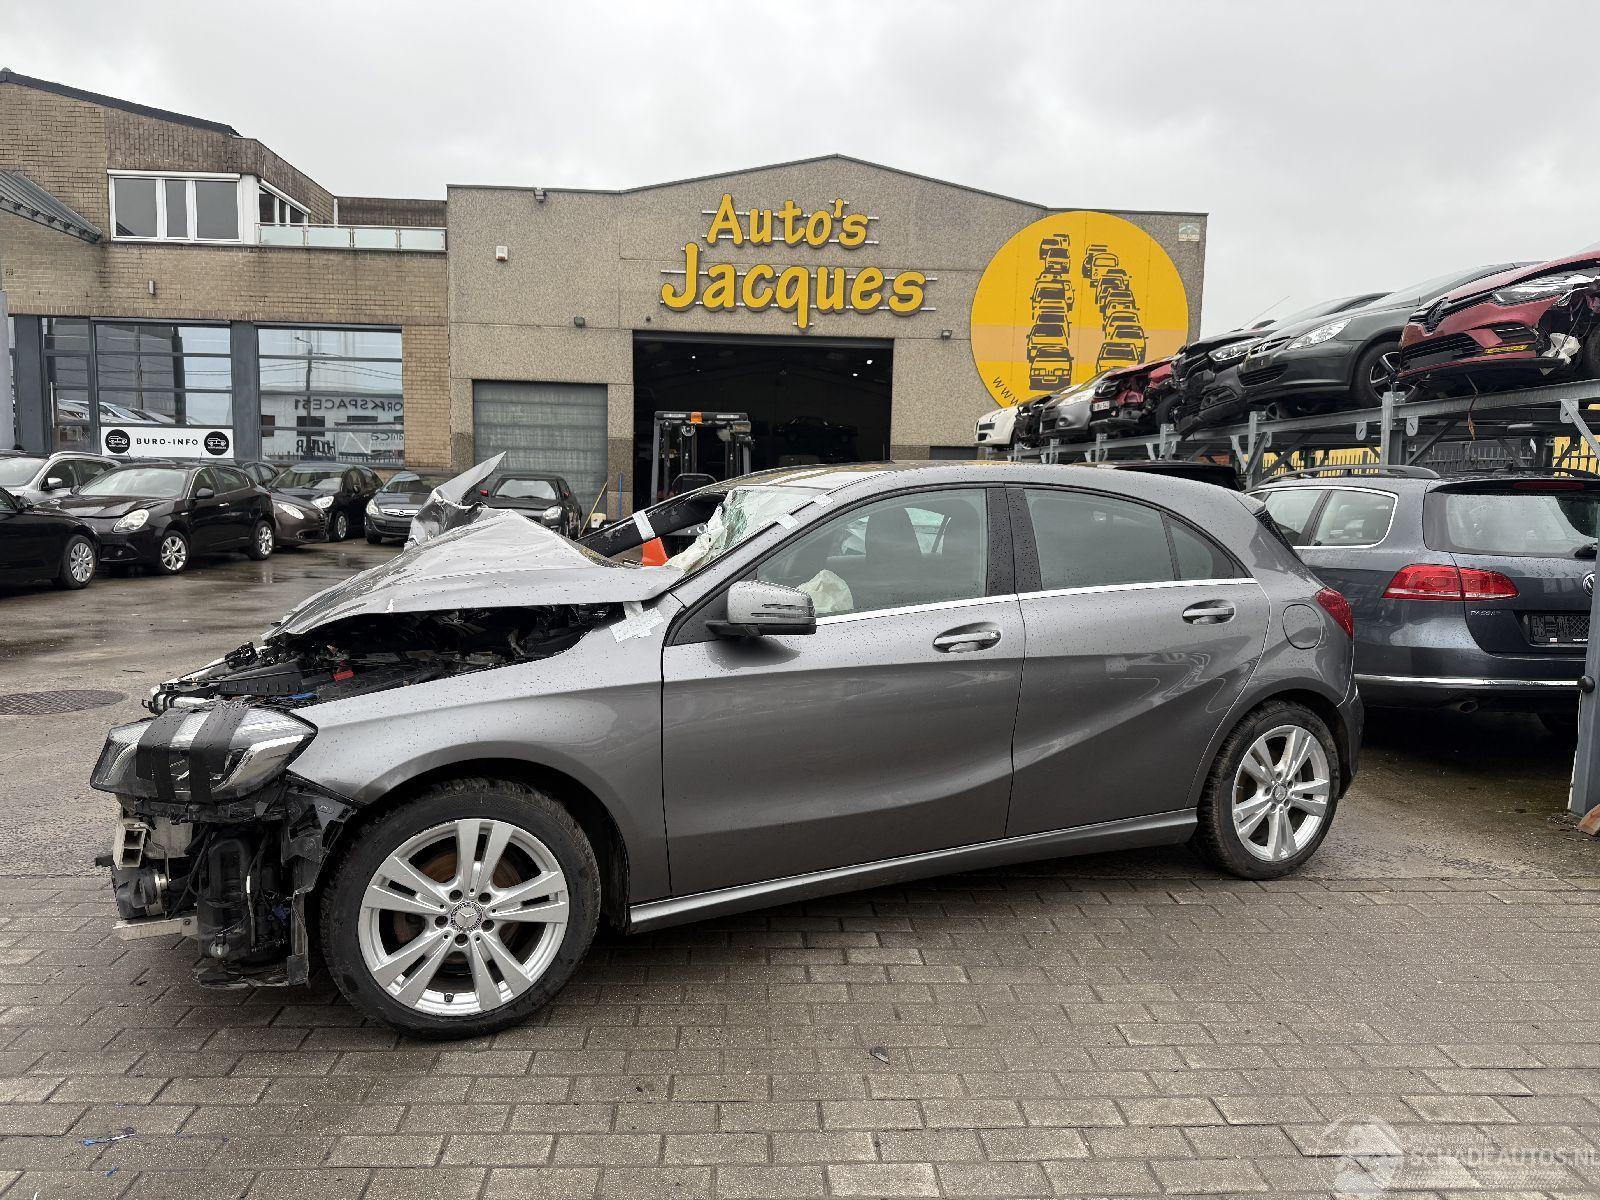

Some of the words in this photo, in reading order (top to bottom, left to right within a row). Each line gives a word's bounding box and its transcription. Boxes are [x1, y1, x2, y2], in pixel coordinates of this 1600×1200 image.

[706, 193, 869, 249] Auto's
[660, 242, 926, 329] Jacques
[136, 438, 199, 446] BURO-INFO
